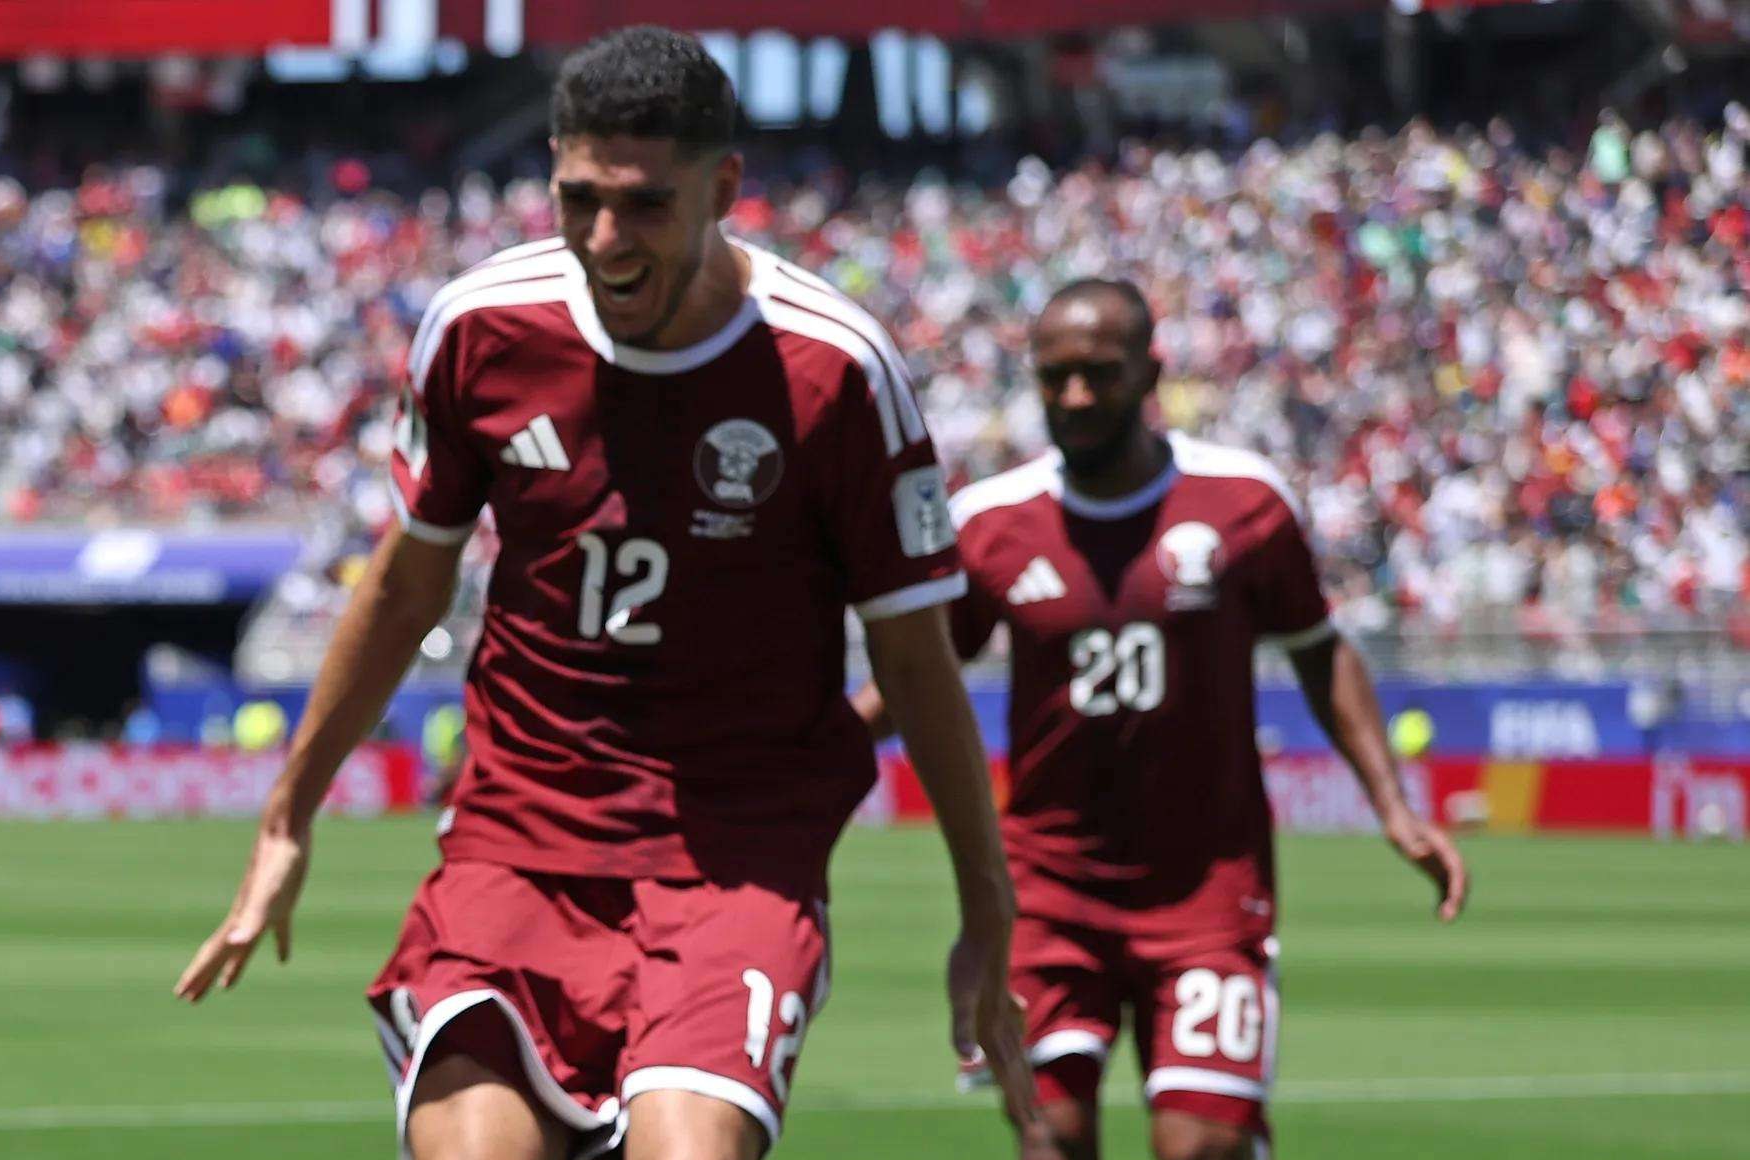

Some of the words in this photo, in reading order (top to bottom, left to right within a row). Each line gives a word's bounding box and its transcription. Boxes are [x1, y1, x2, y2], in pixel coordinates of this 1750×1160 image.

[577, 532, 670, 645] 12
[1068, 620, 1166, 718] 20
[741, 968, 807, 1104] 12
[1171, 966, 1263, 1064] 20
